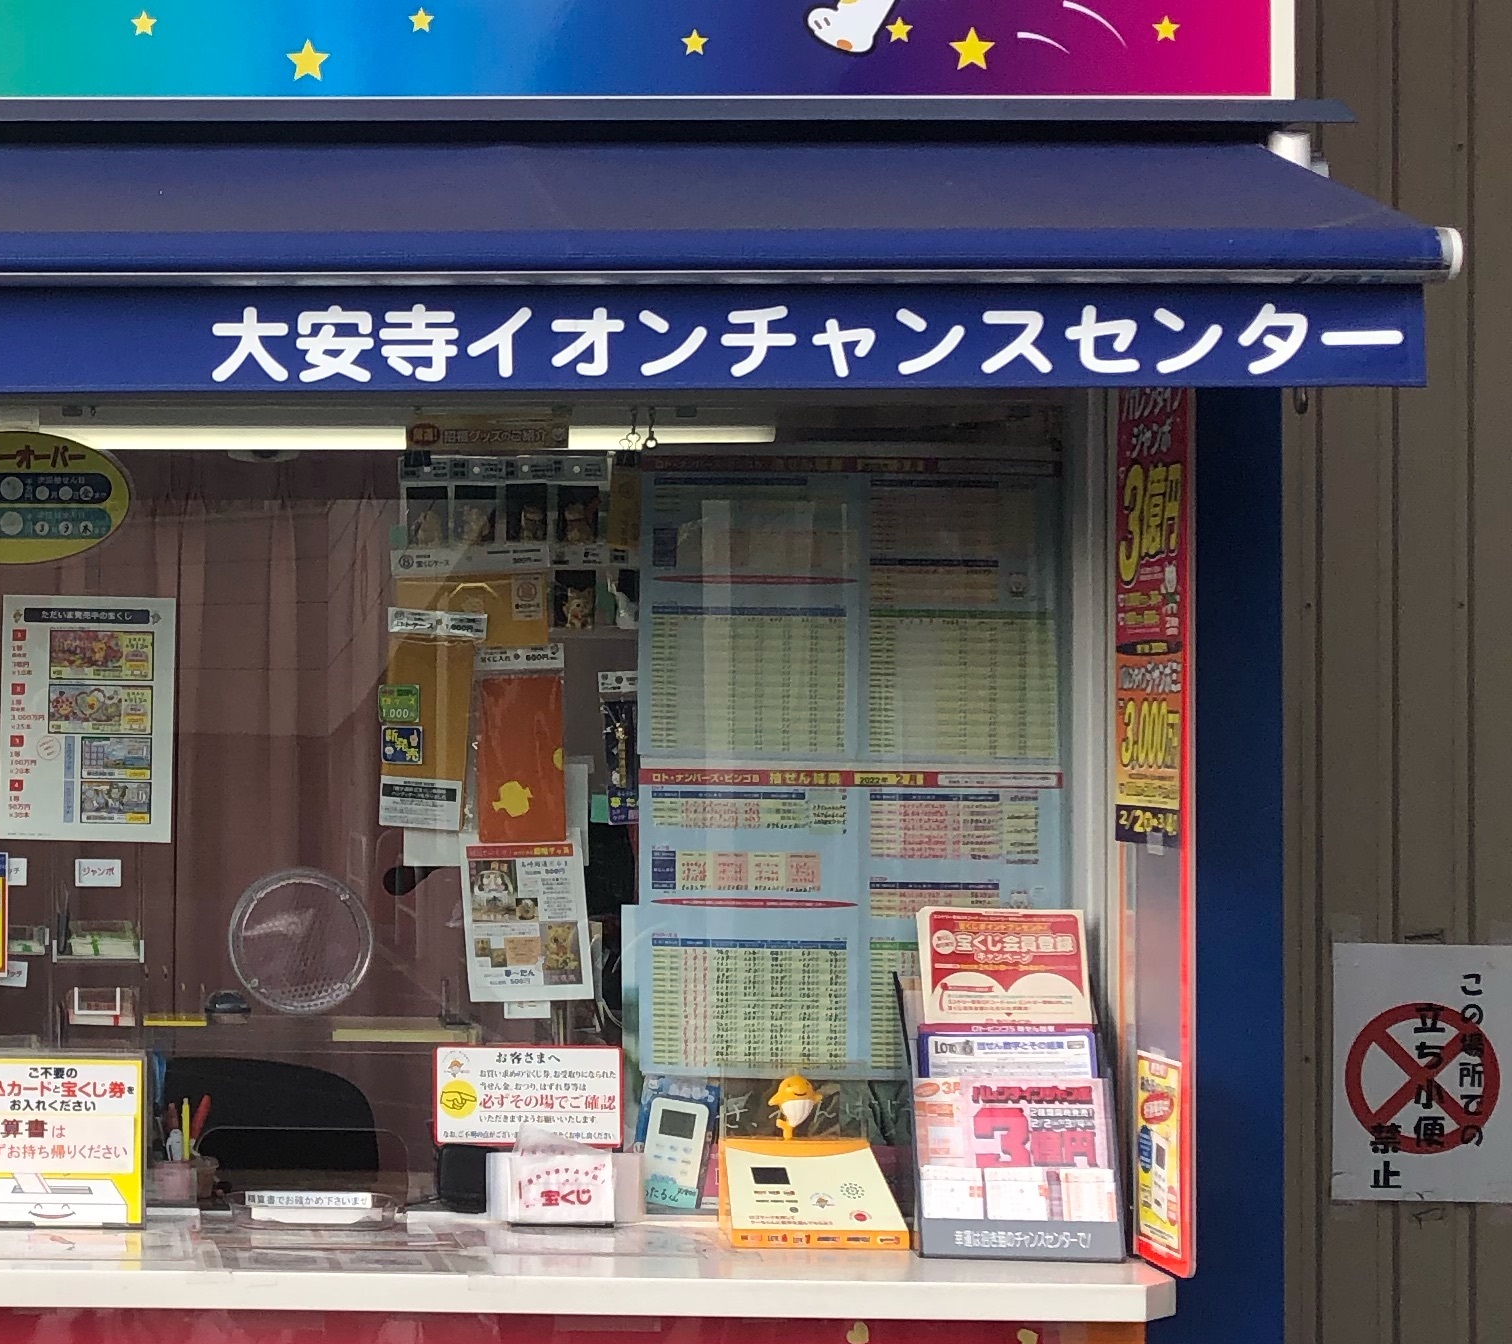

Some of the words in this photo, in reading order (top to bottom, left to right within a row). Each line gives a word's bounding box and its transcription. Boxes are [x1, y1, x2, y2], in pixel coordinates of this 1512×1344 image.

[210, 303, 1405, 385] 大安寺イオンチャンスセンター
[955, 933, 1075, 953] 宝くじ会員登録
[976, 952, 1033, 963] キャンペーン
[495, 1051, 562, 1065] お客さまへ
[1459, 972, 1485, 1147] この場所での
[28, 1066, 79, 1080] ご不要の
[1413, 1002, 1446, 1148] 立ち小便
[9, 1098, 97, 1113] お入れください
[479, 1093, 617, 1111] 必ずその場でご確認
[1369, 1121, 1403, 1190] 禁止
[540, 1188, 592, 1207] 宝くじ
